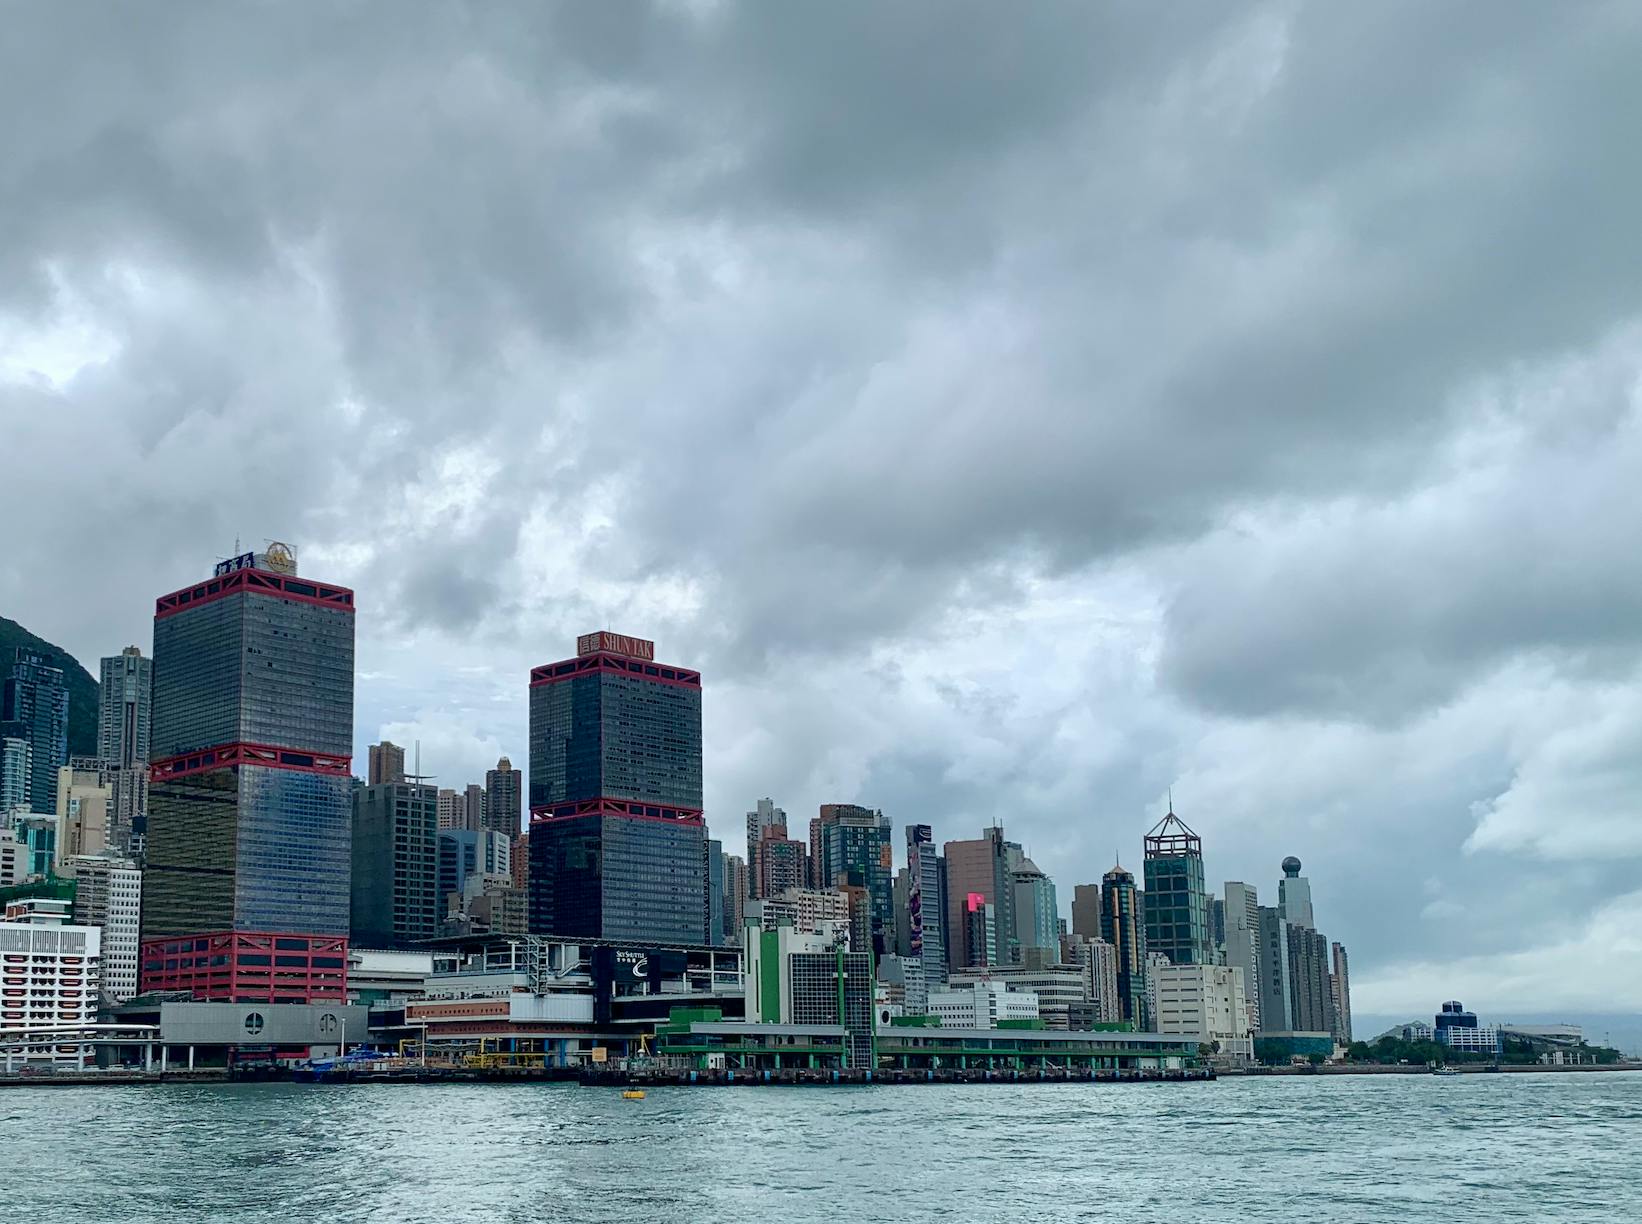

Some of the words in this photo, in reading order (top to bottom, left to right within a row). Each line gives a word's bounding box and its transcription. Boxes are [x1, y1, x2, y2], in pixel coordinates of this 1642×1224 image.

[580, 634, 600, 654] 信德
[603, 633, 630, 653] SHUN
[632, 639, 651, 659] TAK
